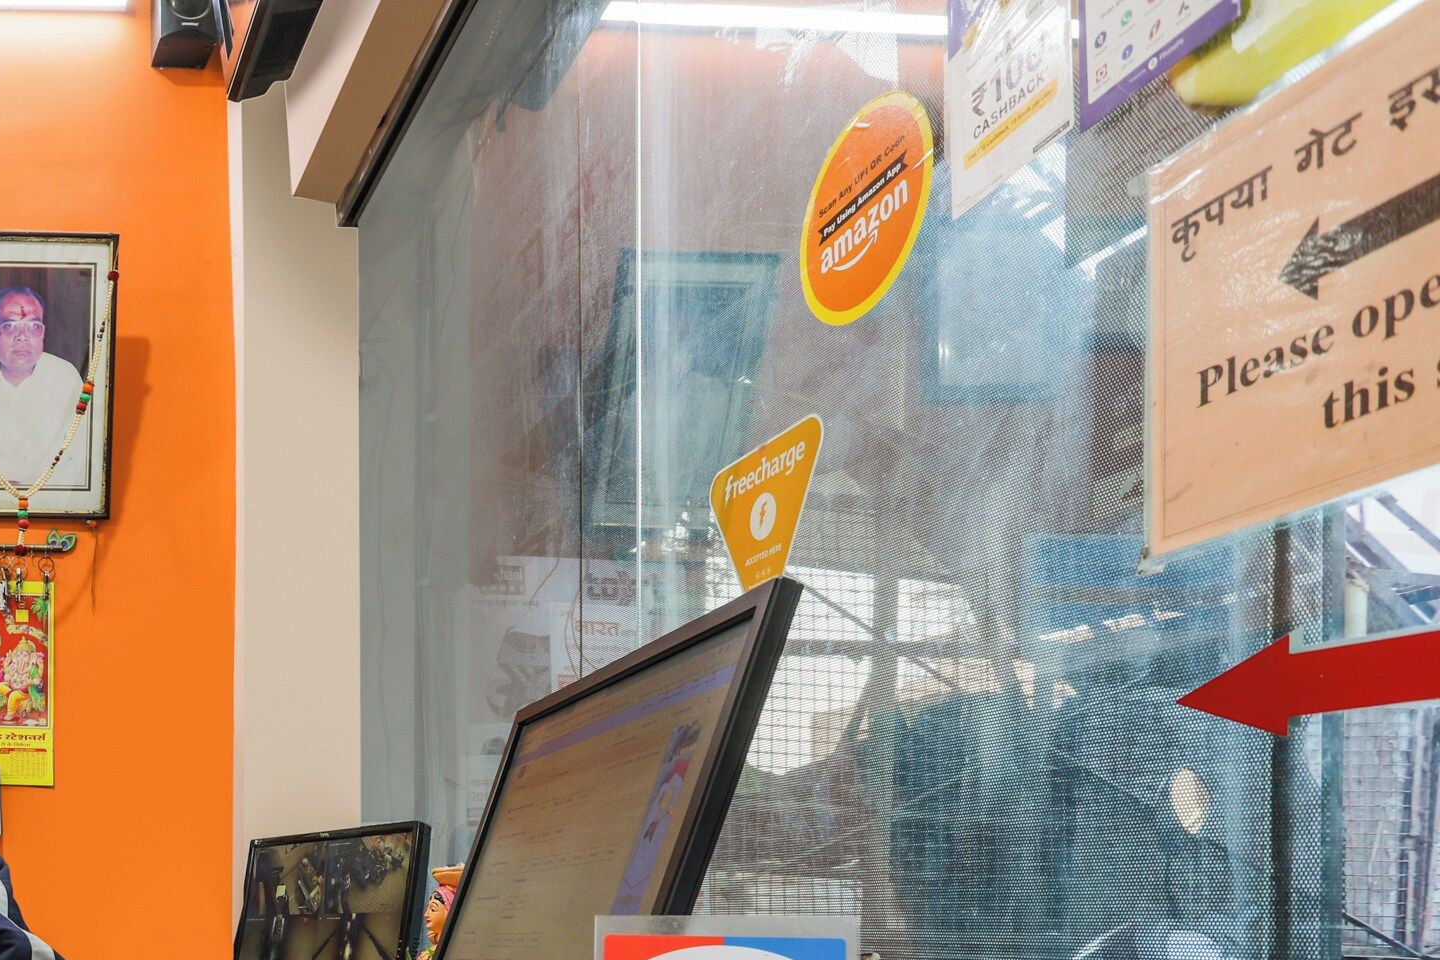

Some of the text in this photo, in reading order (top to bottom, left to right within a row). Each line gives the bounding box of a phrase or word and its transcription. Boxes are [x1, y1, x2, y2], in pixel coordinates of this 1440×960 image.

[973, 72, 1045, 140] CASHBACK
[819, 198, 837, 218] Scan
[839, 184, 853, 200] Any
[854, 167, 868, 185] UPI
[870, 155, 882, 171] QR
[823, 163, 902, 237] Pay Using Amazon App
[1171, 166, 1273, 263] कृपया
[1294, 112, 1363, 173] गेट
[820, 178, 908, 275] amazon
[1196, 273, 1440, 409] Please ope
[1322, 365, 1415, 429] this
[724, 441, 806, 507] freecharge
